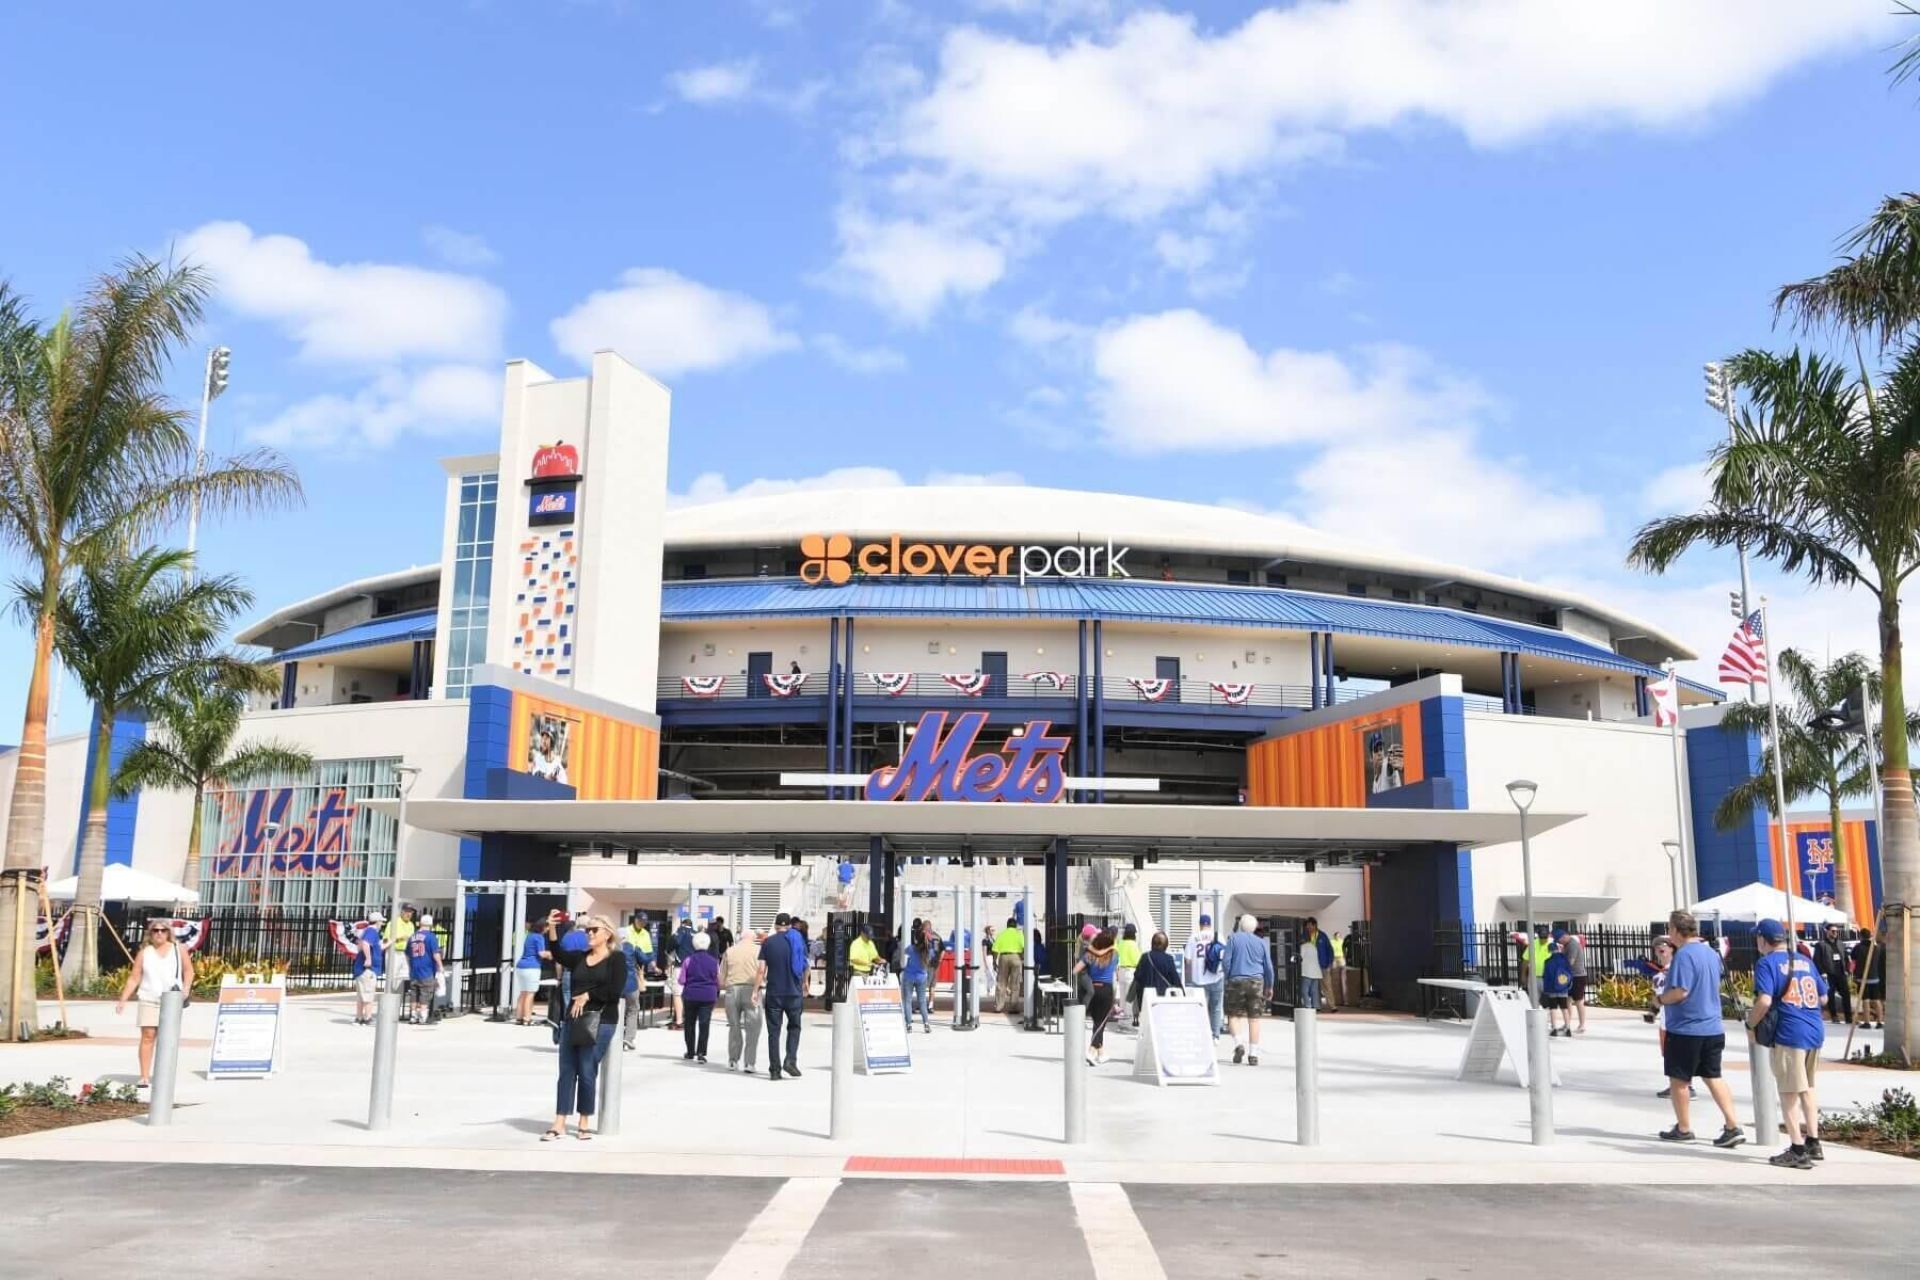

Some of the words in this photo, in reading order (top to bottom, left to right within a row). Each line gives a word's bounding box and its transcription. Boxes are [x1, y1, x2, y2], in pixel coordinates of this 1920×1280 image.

[858, 533, 1013, 575] clover
[1020, 537, 1129, 586] park
[864, 710, 1072, 803] Mets
[213, 787, 357, 875] Mets
[1781, 976, 1818, 1008] 48
